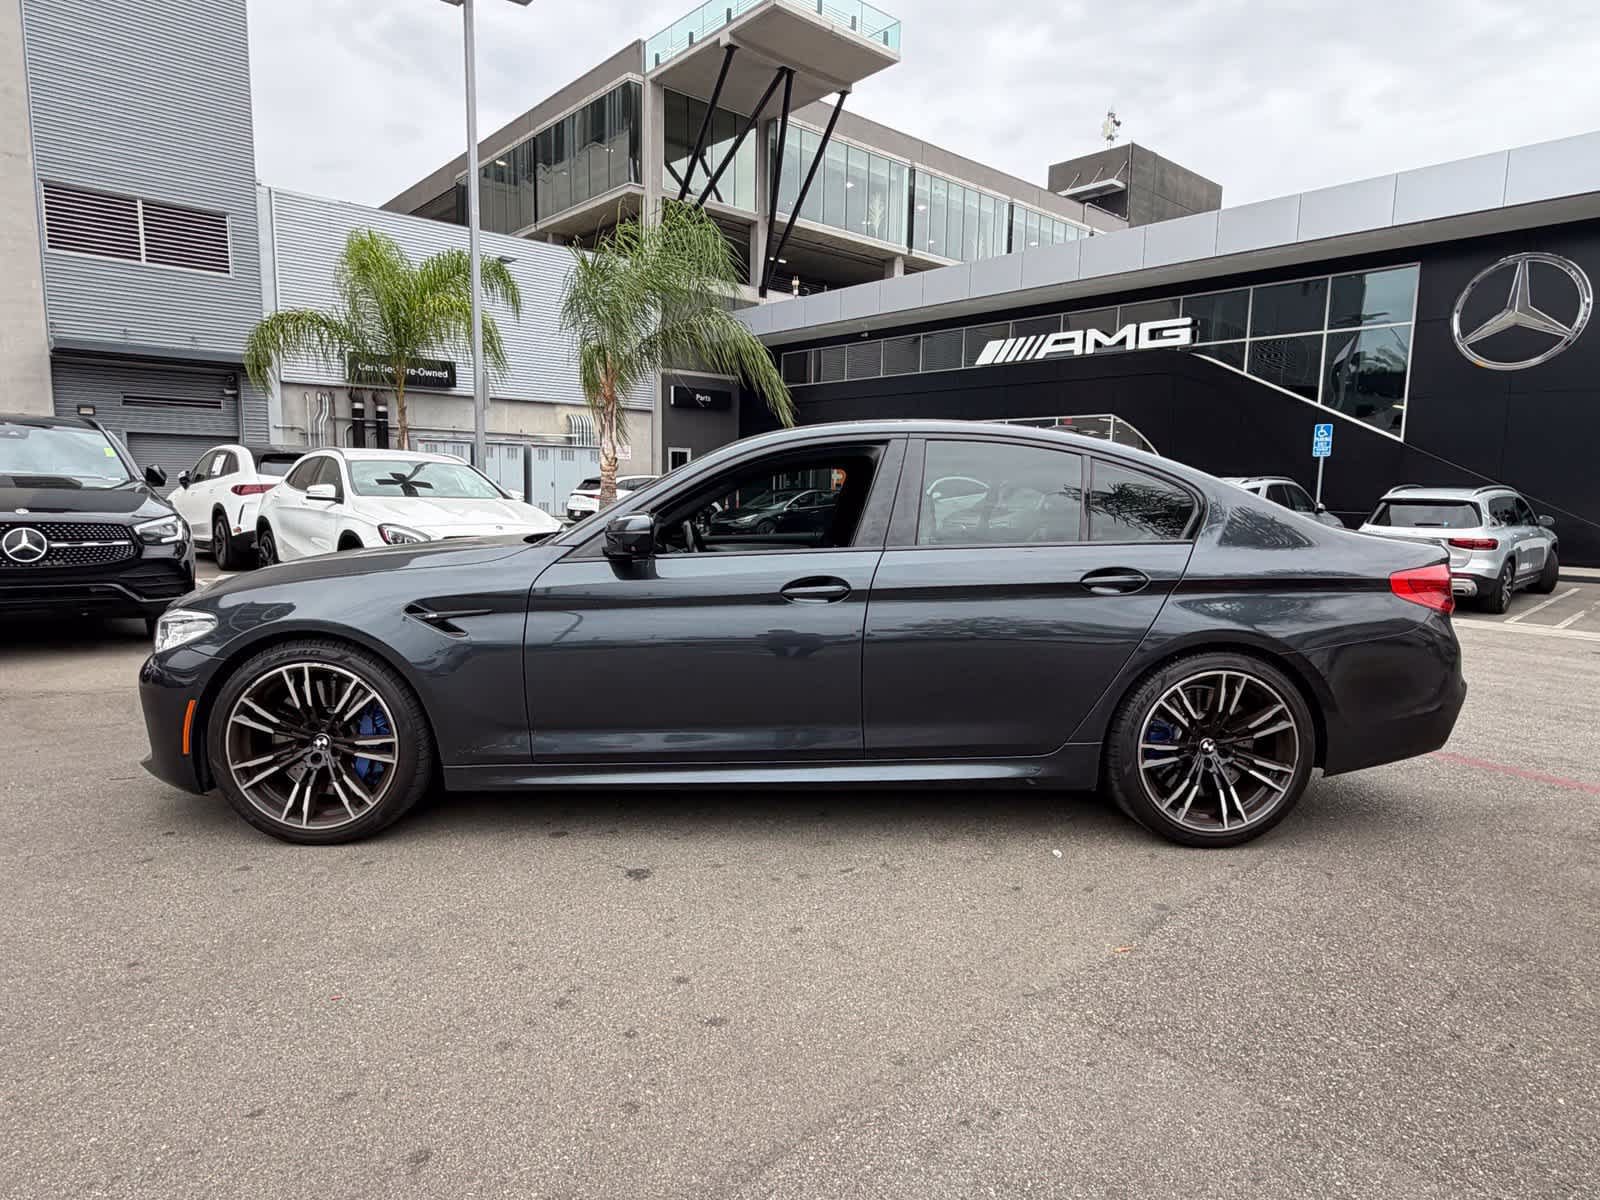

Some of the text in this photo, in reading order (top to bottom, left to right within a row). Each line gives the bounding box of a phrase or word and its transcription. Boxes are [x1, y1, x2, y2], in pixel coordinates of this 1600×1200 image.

[1034, 317, 1193, 360] AMG
[403, 367, 449, 379] re-Owned
[695, 393, 712, 402] Parts
